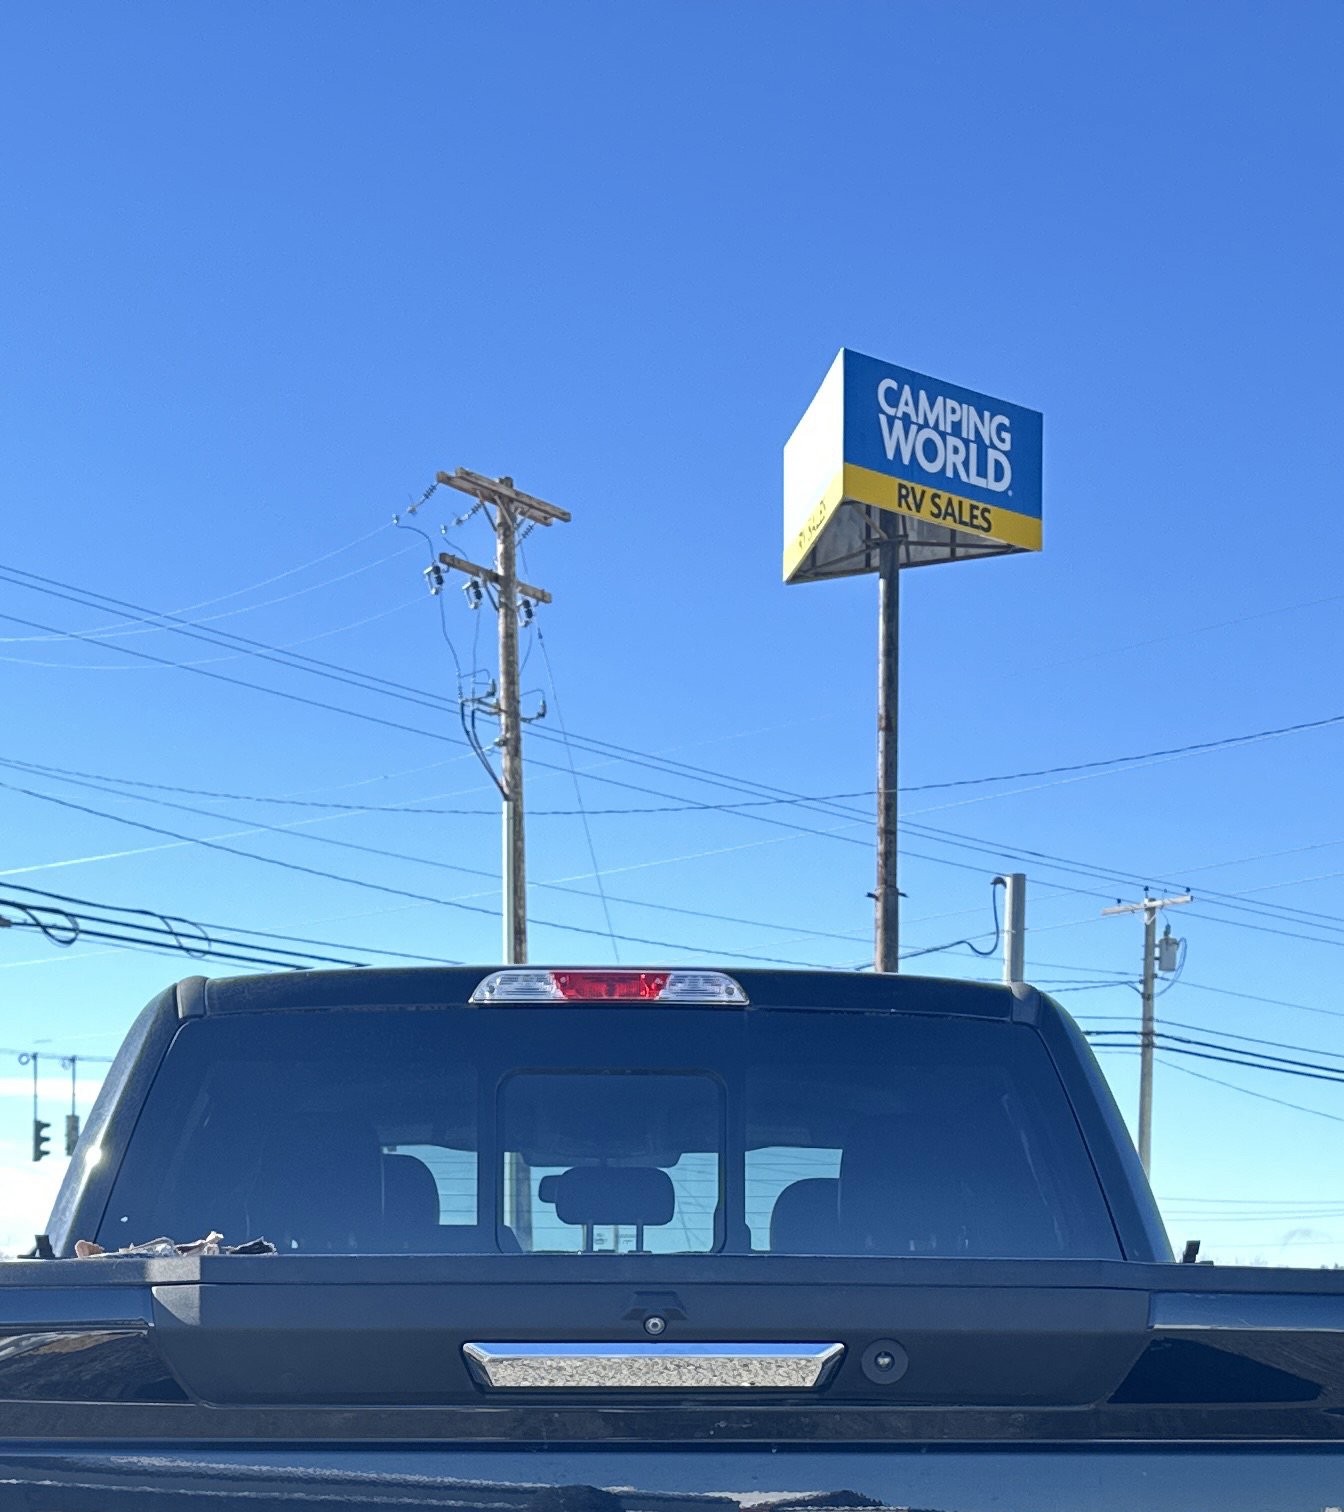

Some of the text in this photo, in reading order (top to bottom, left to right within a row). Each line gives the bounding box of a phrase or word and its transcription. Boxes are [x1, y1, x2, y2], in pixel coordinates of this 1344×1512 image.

[877, 378, 1011, 452] CAMPING
[879, 413, 1012, 493] WORLD
[897, 482, 992, 533] RV SALES
